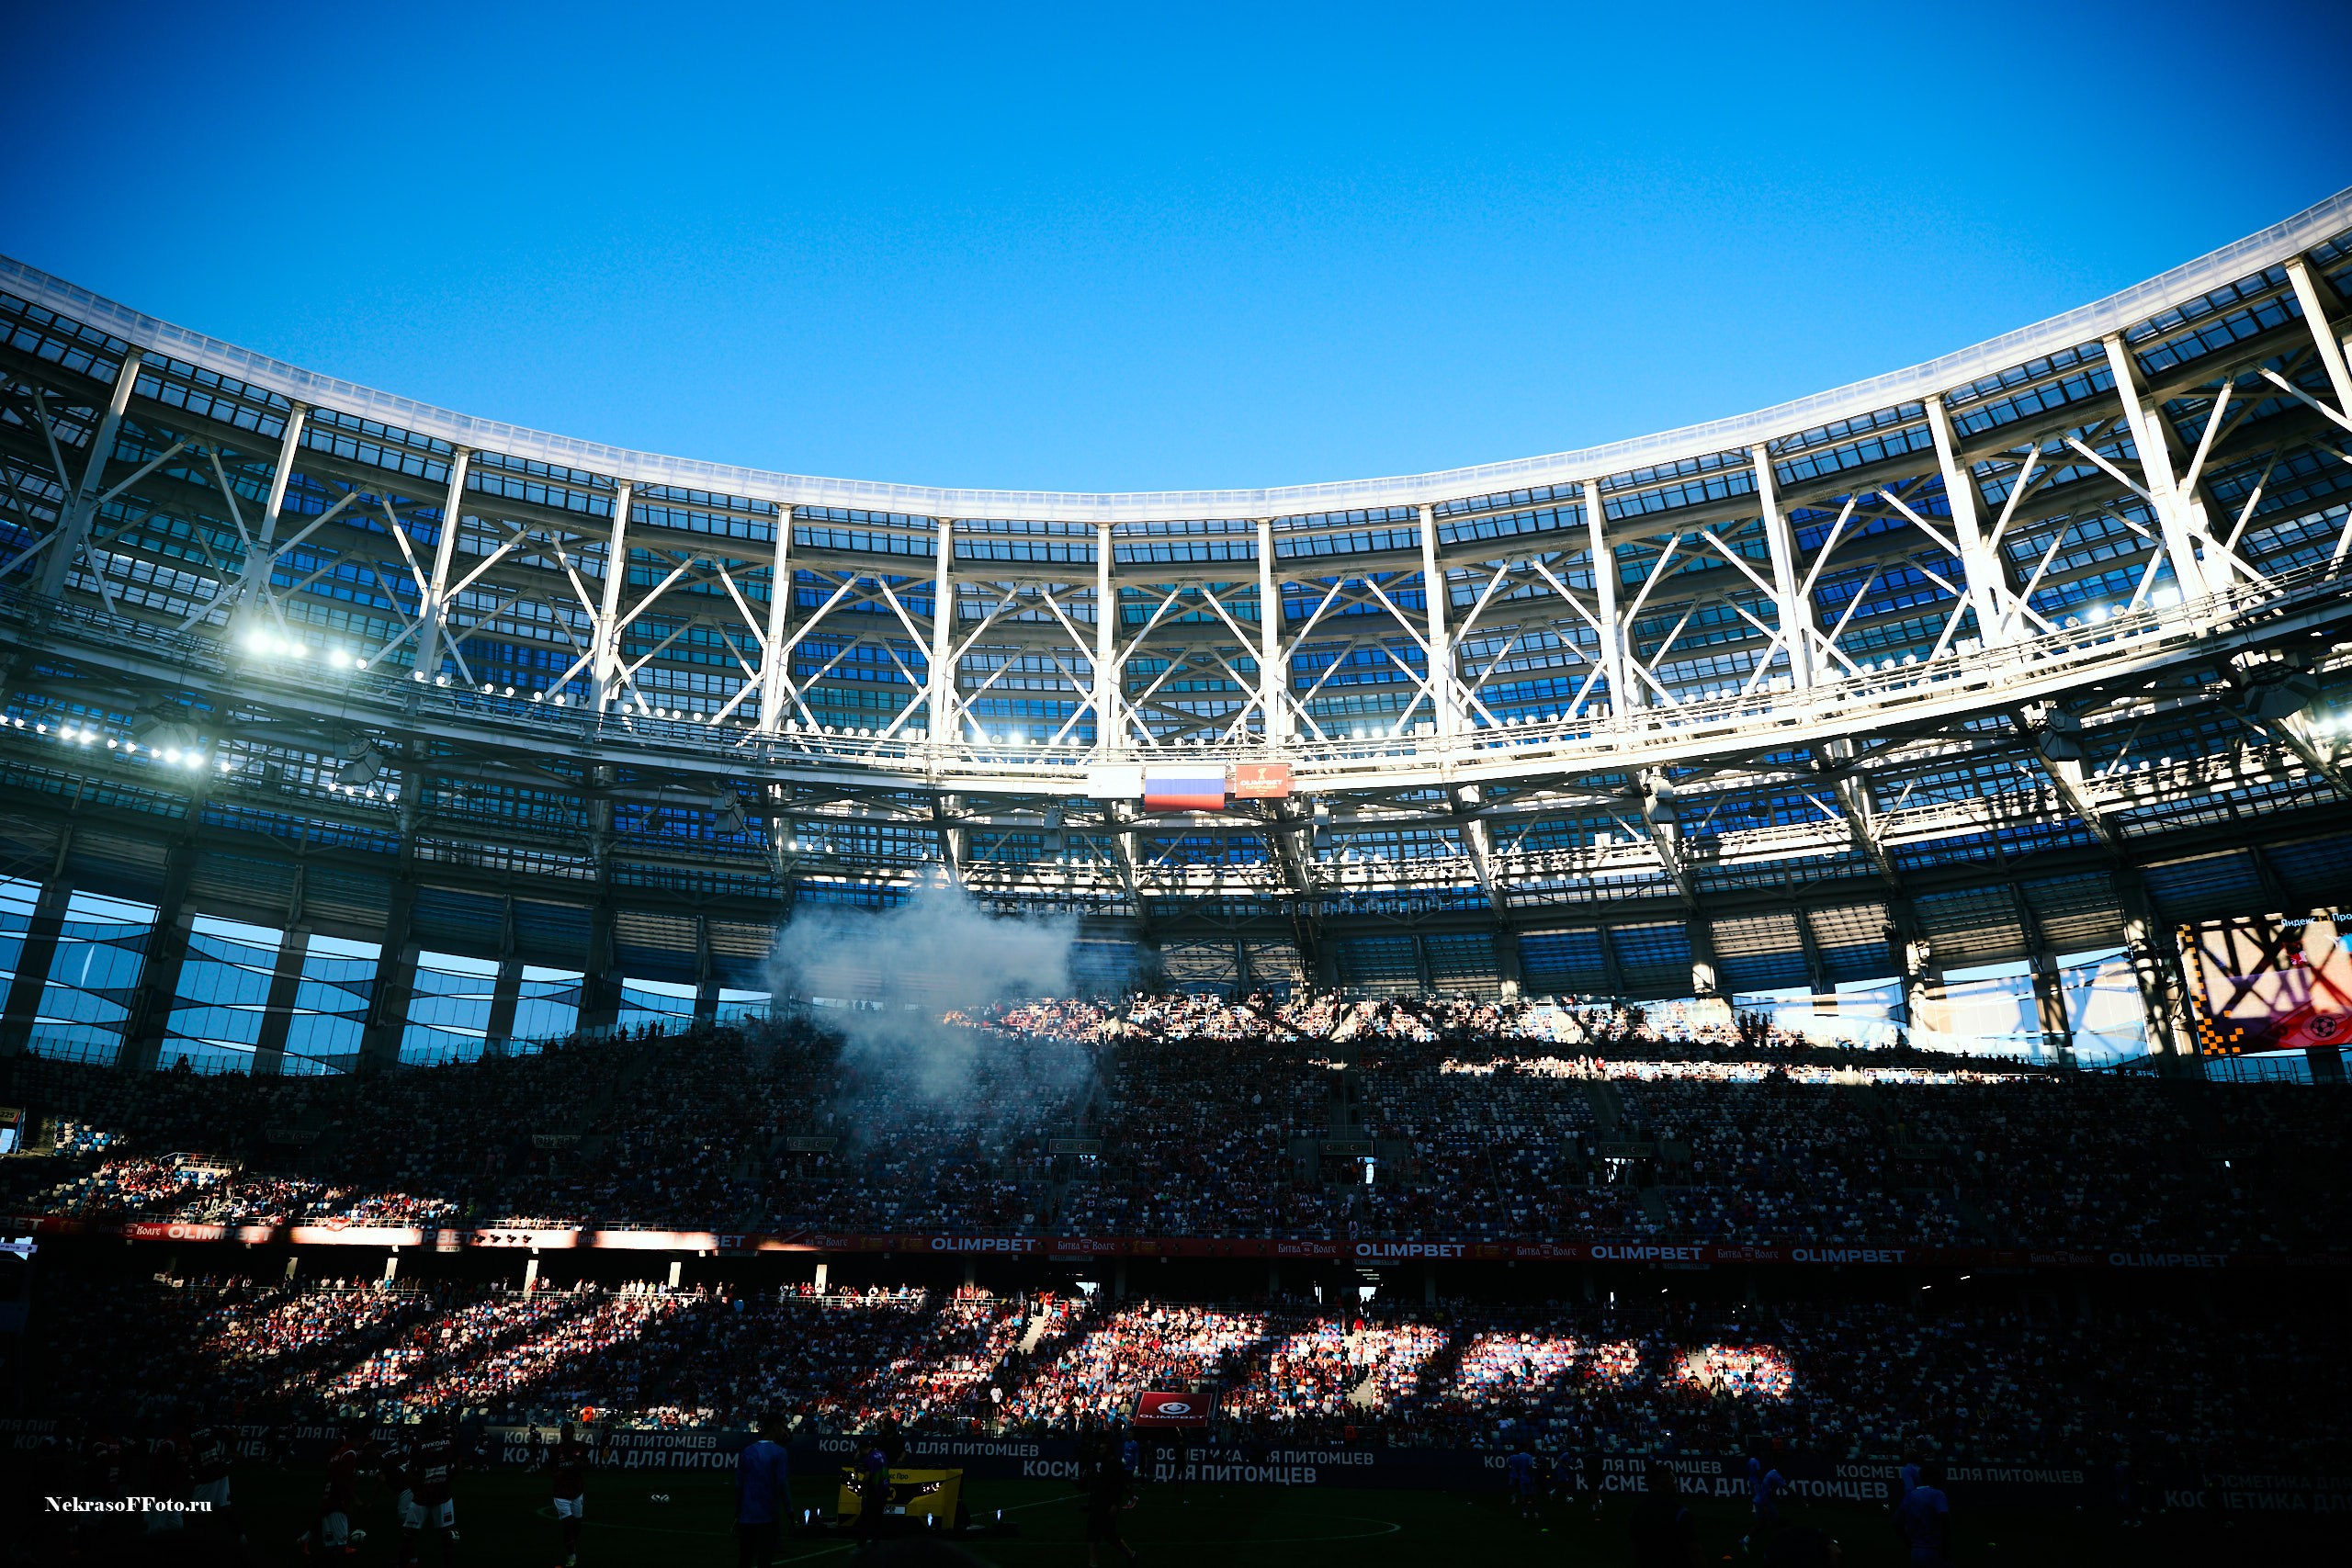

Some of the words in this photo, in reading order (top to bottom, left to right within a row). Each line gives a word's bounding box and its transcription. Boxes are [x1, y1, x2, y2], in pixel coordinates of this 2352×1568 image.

[2281, 917, 2316, 928] Яндекс
[0, 1216, 44, 1232] BET
[168, 1225, 274, 1242] OLIMPBET
[931, 1237, 1036, 1252] OLIMPBET
[1355, 1243, 1466, 1258] OLIMPBET
[1590, 1245, 1703, 1260] OLIMPBET
[1792, 1247, 1906, 1263] OLIMPBET
[2109, 1253, 2228, 1268] OLIMPBET
[633, 1434, 718, 1450] ПИТОМЦЕВ
[916, 1441, 949, 1456] ДЛЯ
[953, 1442, 1040, 1458] ПИТОМЦЕВ
[624, 1450, 667, 1469] ДЛЯ
[671, 1450, 740, 1468] ПИТОМ
[1283, 1450, 1374, 1467] ПИТОМЦЕВ
[1023, 1460, 1080, 1478] КОСМ
[1202, 1464, 1317, 1485] ПИТОМЦЕВ
[1836, 1464, 1904, 1479] КОСМЕТ
[1946, 1467, 1983, 1482] ДЛЯ
[1986, 1468, 2086, 1484] ПИТОМЦЕВ
